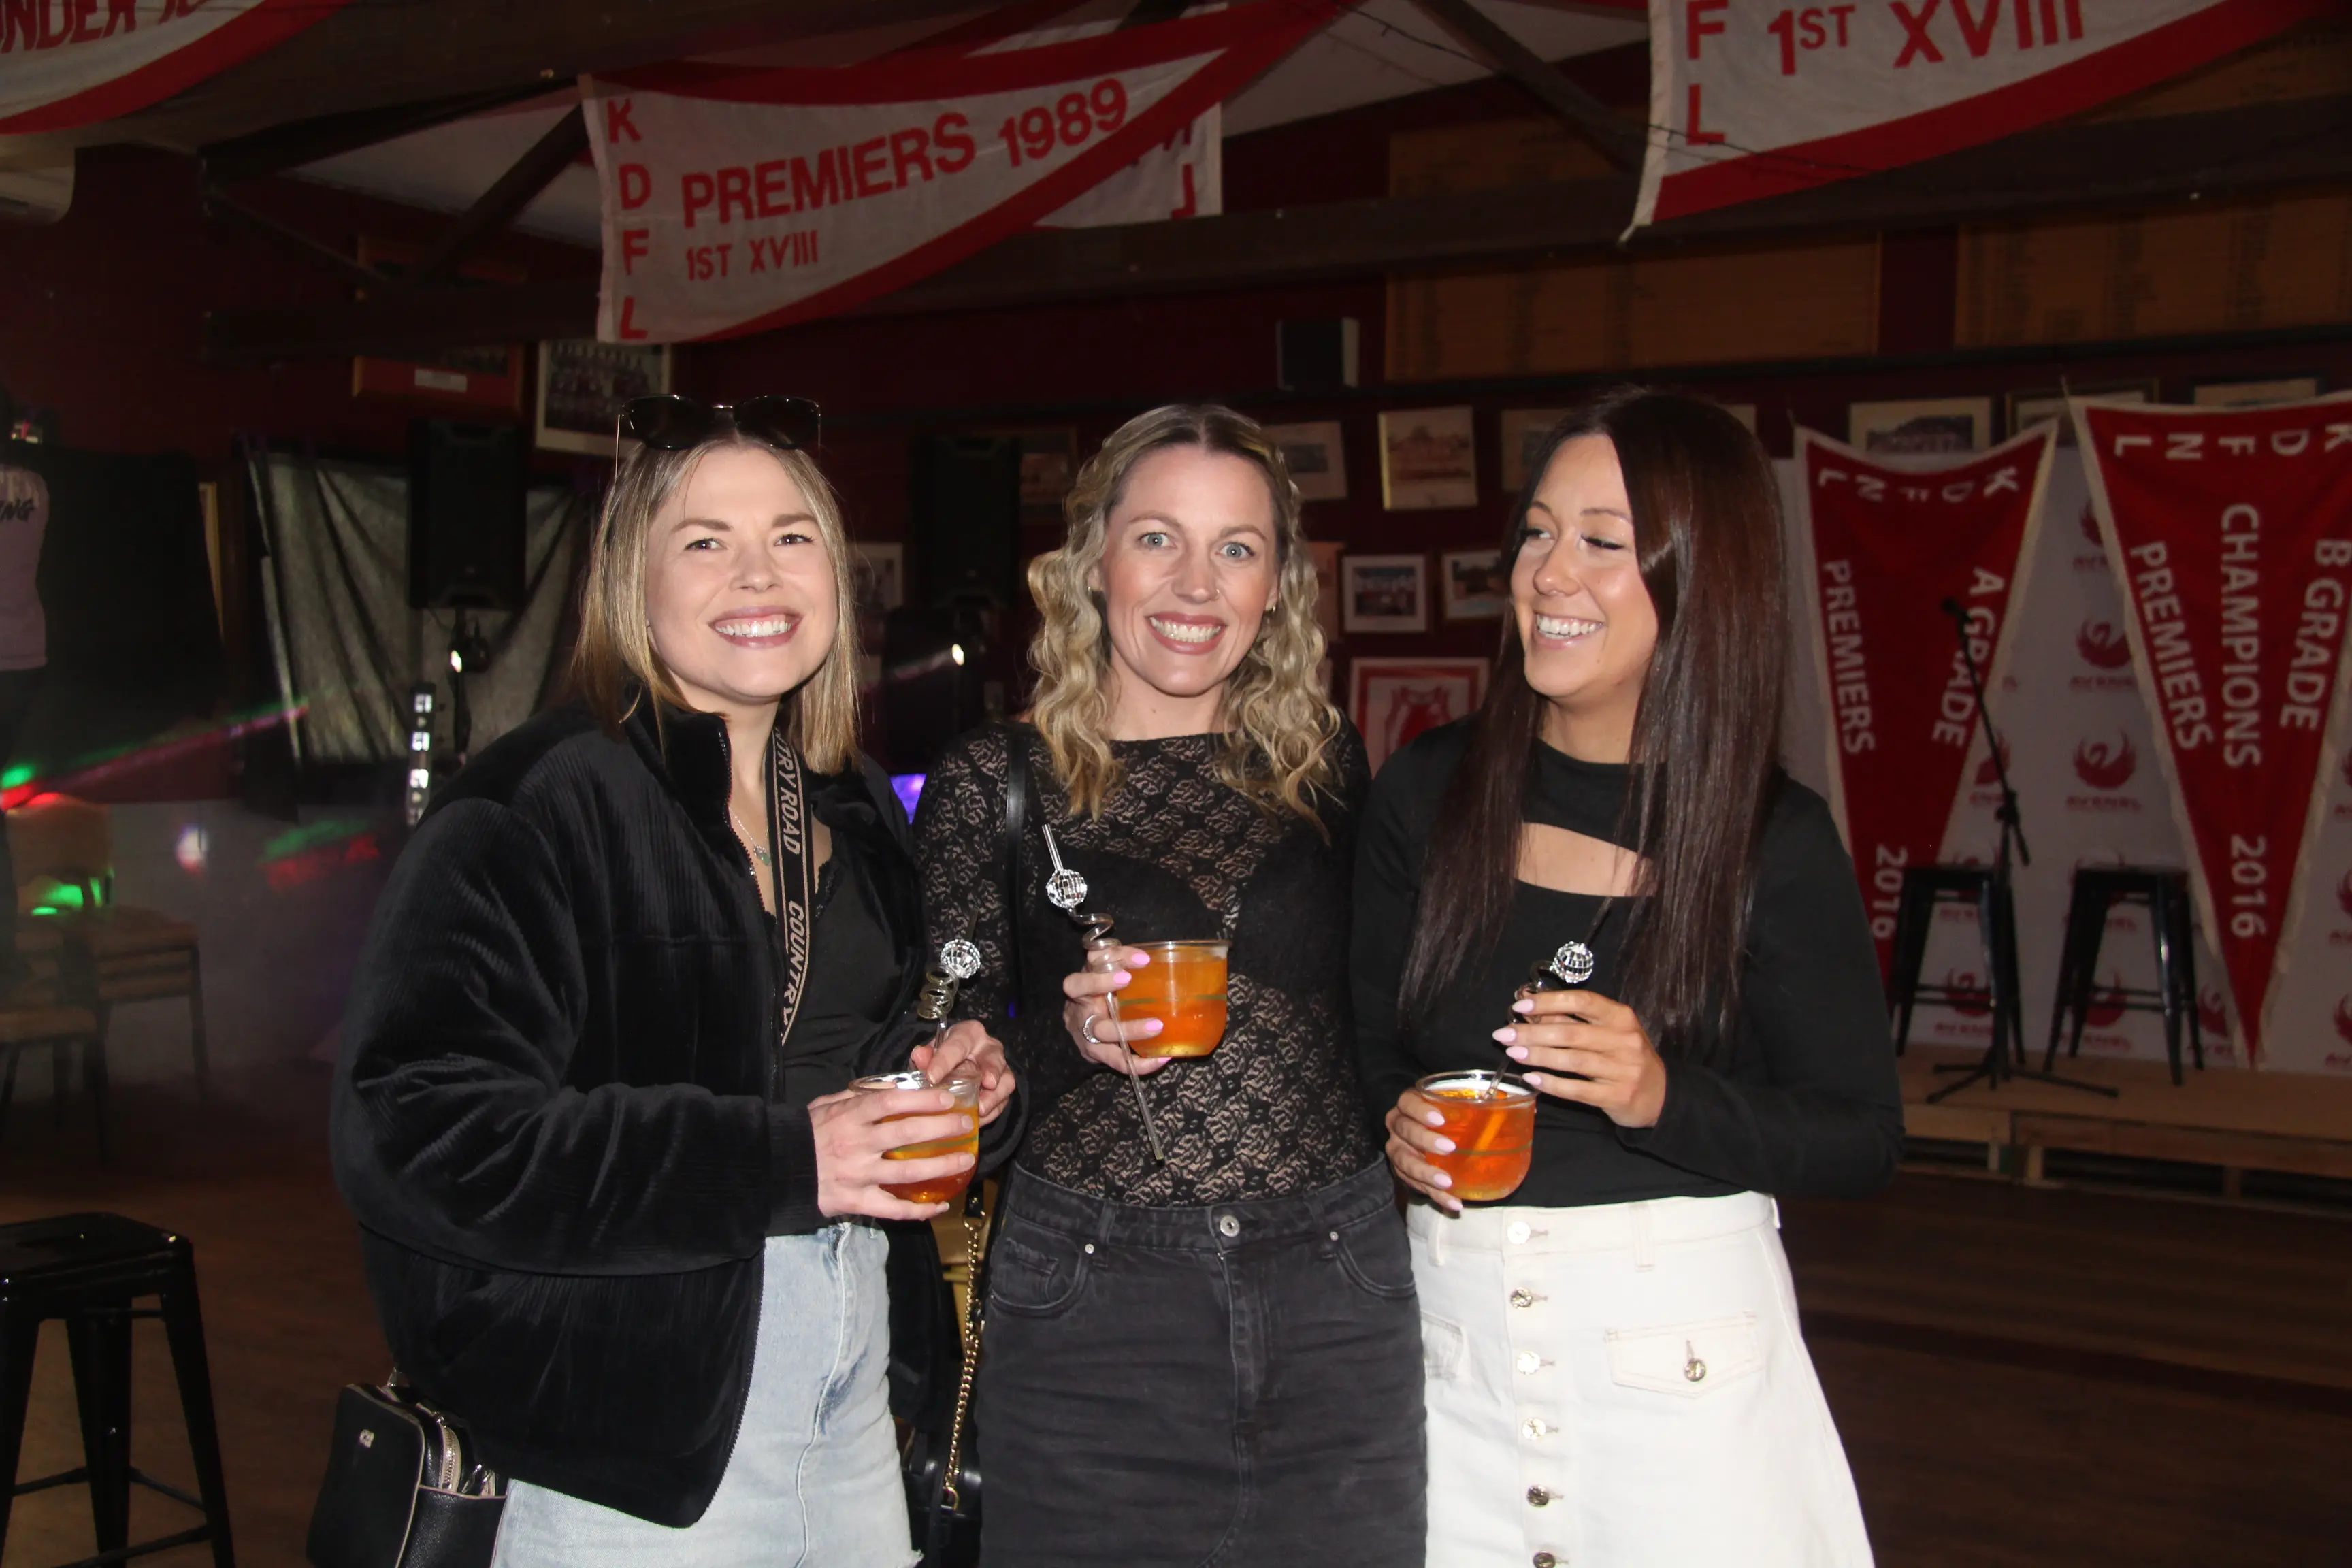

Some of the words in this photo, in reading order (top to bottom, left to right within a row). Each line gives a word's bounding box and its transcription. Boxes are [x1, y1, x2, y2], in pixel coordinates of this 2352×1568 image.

[1768, 7, 1855, 76] 1ST
[683, 112, 975, 228] PREMIERS
[998, 78, 1127, 167] 1989
[687, 243, 733, 281] 1ST
[749, 230, 819, 274] XVIII
[1968, 566, 2005, 597] A
[2315, 538, 2352, 568] B
[1823, 559, 1876, 755] PREMIERS
[2129, 540, 2215, 751] PREMIERS
[2220, 503, 2262, 769] CHAMPIONS
[2278, 577, 2345, 732] GRADE
[780, 786, 801, 855] ROAD
[2230, 833, 2267, 938] 2016
